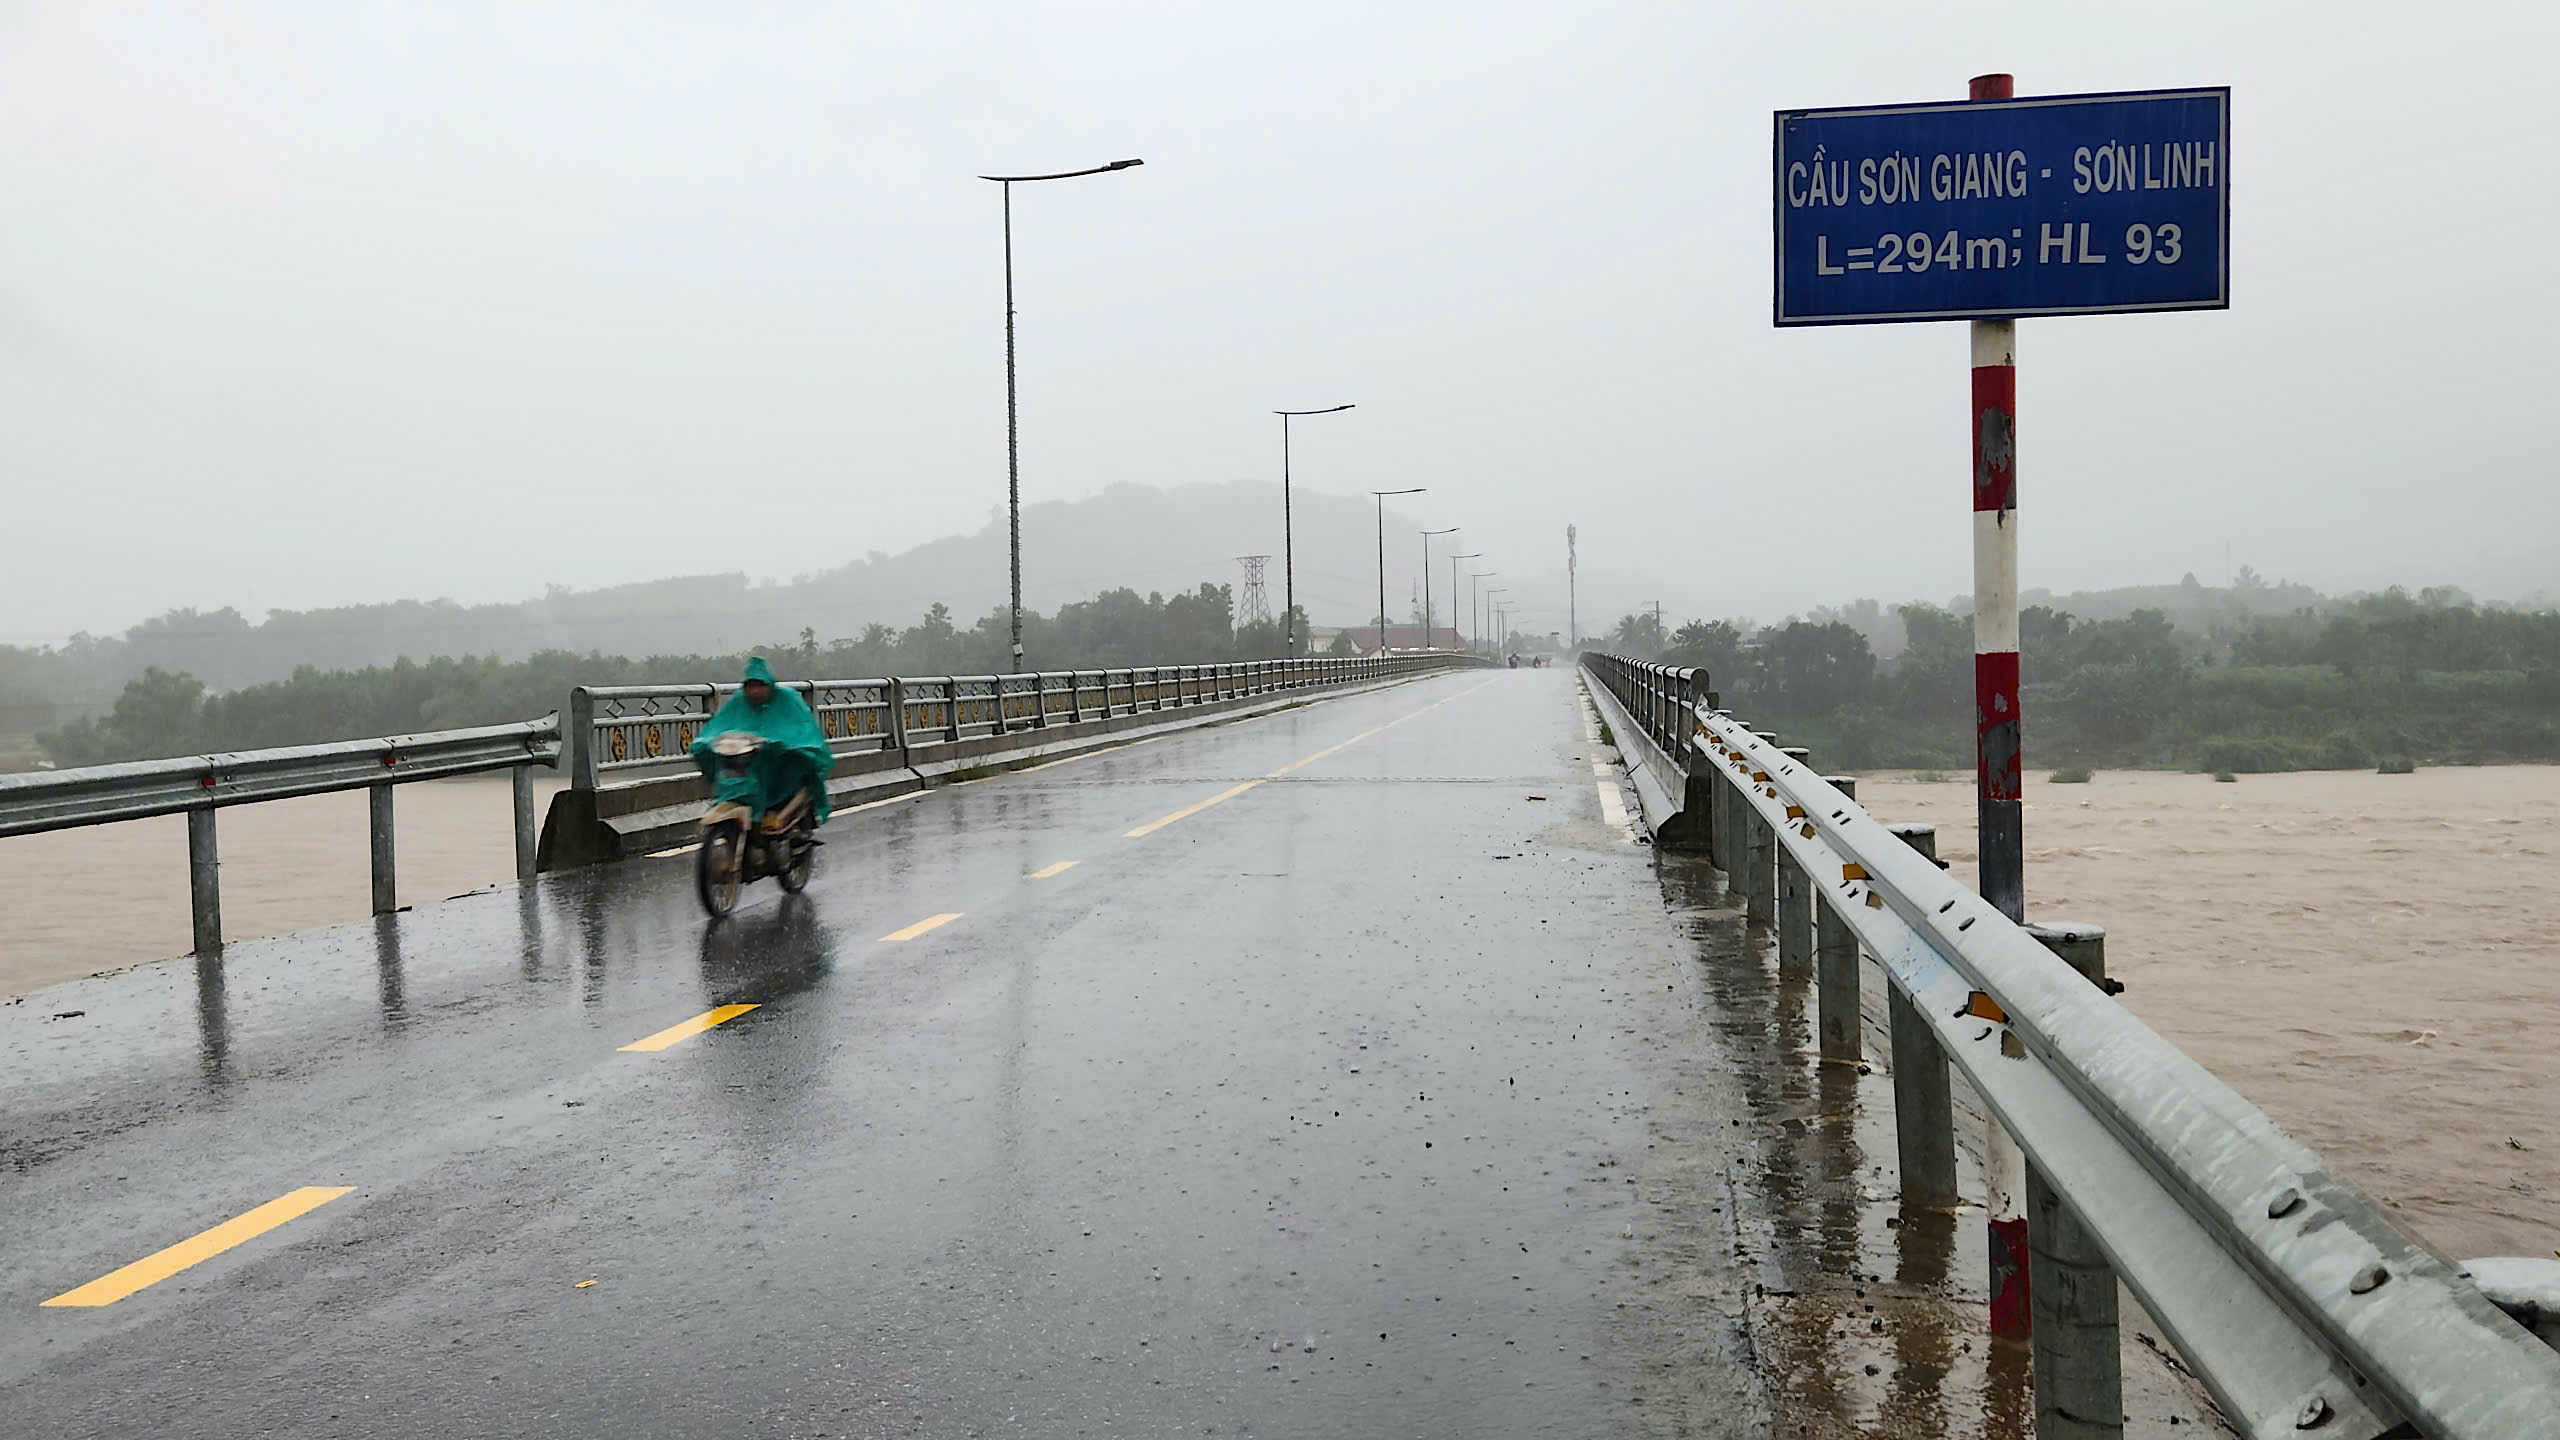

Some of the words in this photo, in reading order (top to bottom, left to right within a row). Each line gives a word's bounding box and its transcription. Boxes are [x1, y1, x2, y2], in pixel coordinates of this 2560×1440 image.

[1788, 144, 1849, 208] CẦU
[1859, 151, 1920, 206] SƠN
[1930, 150, 2027, 202] GIANG
[2073, 139, 2136, 194] SƠN
[2144, 141, 2215, 189] LINH
[1818, 228, 2022, 275] L=294m;
[2039, 223, 2107, 265] HL
[2126, 223, 2182, 265] 93
